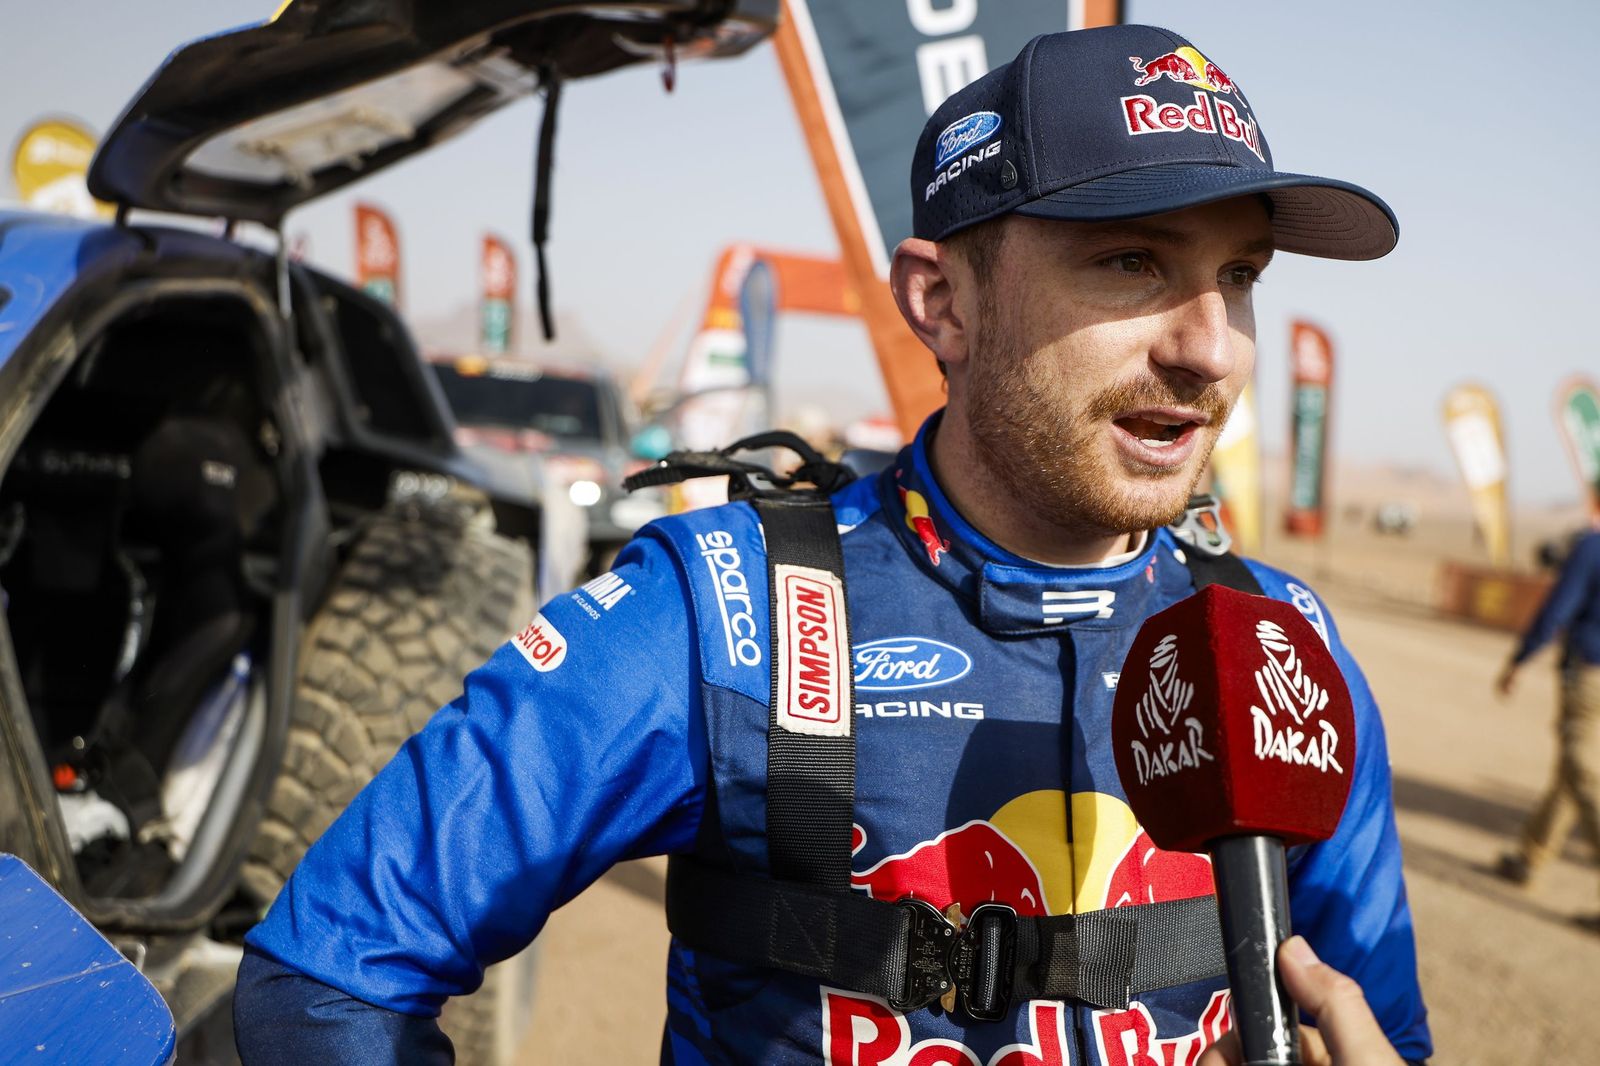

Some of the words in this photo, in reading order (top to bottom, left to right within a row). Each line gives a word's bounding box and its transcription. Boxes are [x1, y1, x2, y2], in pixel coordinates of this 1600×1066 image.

[938, 118, 983, 162] Ford
[1121, 92, 1217, 135] Red
[1214, 97, 1265, 162] Bull
[925, 140, 1002, 202] RACING
[700, 530, 762, 667] sparco
[796, 585, 831, 714] SIMPSON
[853, 644, 942, 683] Ford
[855, 701, 985, 721] ACING
[1251, 705, 1344, 774] DAKAR
[1131, 717, 1215, 786] DAKAR
